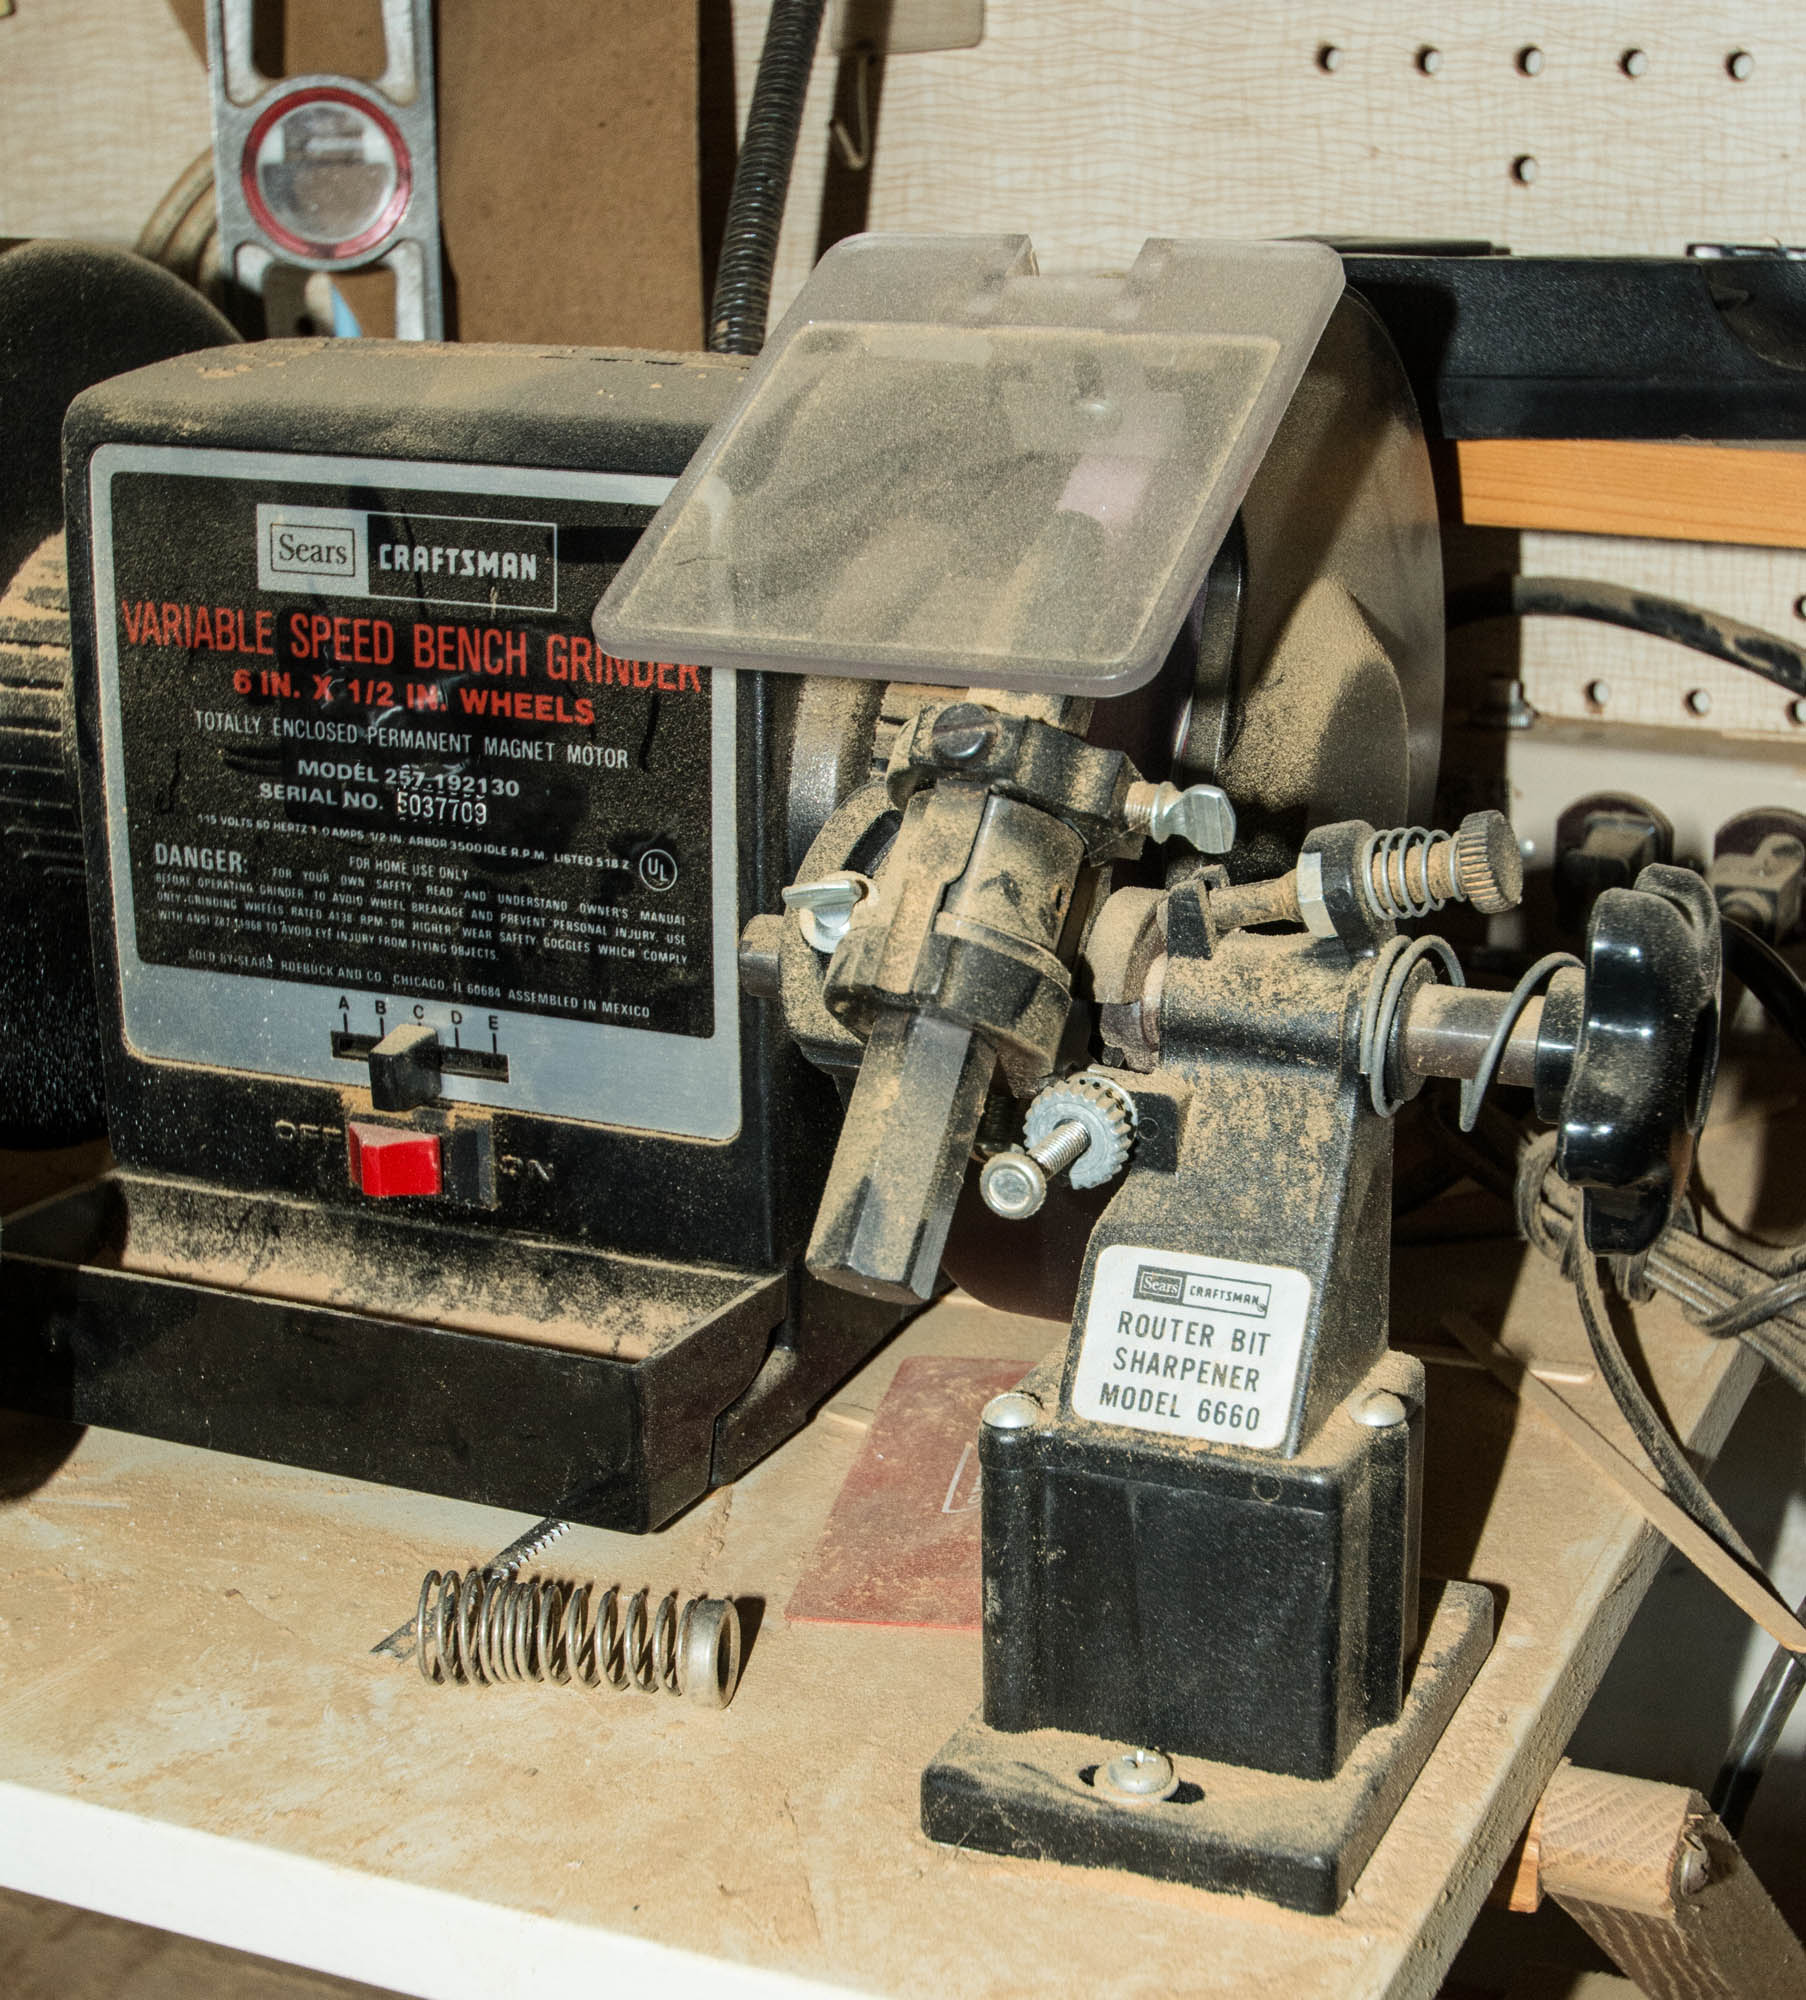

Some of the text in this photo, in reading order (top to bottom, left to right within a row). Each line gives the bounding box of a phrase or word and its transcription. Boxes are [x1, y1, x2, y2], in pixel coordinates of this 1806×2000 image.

[278, 533, 537, 581] Sears CRAFTSMAN
[122, 600, 275, 655] VARIABLE
[290, 613, 395, 665] SPEED
[413, 623, 527, 678] BENCH
[233, 669, 595, 726] 6 IN. X 1/2 IN. WHEELS
[195, 710, 629, 769] TOTALLY ENCLOSED PERMANENT MAGNET MOTOR
[297, 759, 379, 783] MODEL
[258, 782, 488, 825] SERIAL NO. 5037709
[155, 842, 248, 874] DANGER:
[220, 815, 254, 829] VOLTS
[256, 819, 270, 830] 60
[273, 821, 308, 834] HERTZ
[331, 827, 365, 841] AMPS
[408, 835, 448, 850] ARBOR
[450, 840, 482, 853] 3500
[483, 843, 508, 857] IDLE
[553, 853, 593, 867] LISTED
[349, 855, 469, 881] FOR HOME USE ONLY
[155, 872, 191, 886] BEFORE
[198, 877, 254, 893] OPERATING
[259, 883, 304, 899] GRINDER
[314, 890, 326, 901] TO
[332, 892, 363, 907] AVOID
[370, 896, 406, 912] WHEEL
[411, 901, 465, 918] BREAKAGE
[471, 909, 494, 922] AND
[500, 912, 546, 928] PREVENT
[553, 919, 608, 937] PERSONAL
[666, 934, 687, 946] USE
[271, 867, 292, 879] FOR
[302, 870, 330, 883] YOUR
[340, 874, 365, 888] OWN
[426, 884, 453, 898] READ
[463, 889, 487, 902] AND
[498, 893, 568, 912] UNDERSTAND
[579, 902, 629, 920] OWNER'S
[639, 910, 686, 926] MANUAL
[156, 891, 181, 903] ONLY
[187, 894, 238, 911] GRINDING
[244, 901, 285, 916] WHEELS
[291, 905, 323, 920] RATED
[391, 917, 406, 929] OR
[462, 926, 492, 940] WEAR
[499, 931, 537, 946] SAFETY
[543, 937, 590, 953] GOGGLES
[598, 943, 636, 959] WHICH
[643, 949, 688, 965] COMPLY
[159, 909, 183, 921] WITH
[187, 912, 210, 925] ANSI
[266, 921, 278, 934] TO
[281, 924, 312, 937] AVOID
[316, 927, 332, 940] EYE
[336, 930, 375, 944] INJURY
[378, 935, 408, 949] FROM
[411, 939, 447, 954] FLYING
[281, 959, 334, 977] ROEBUCK
[338, 966, 362, 981] AND
[452, 981, 463, 993] IL
[508, 988, 579, 1009] ASSEMBLED
[583, 999, 597, 1011] IN
[601, 1001, 650, 1018] MEXICO
[338, 995, 499, 1031] A B C D E
[275, 1119, 341, 1142] OFF
[1141, 1274, 1178, 1296] Sears
[1117, 1310, 1271, 1357] ROUTER BIT
[1112, 1346, 1260, 1393] SHARPENER
[1099, 1382, 1260, 1432] MODEL 6660
